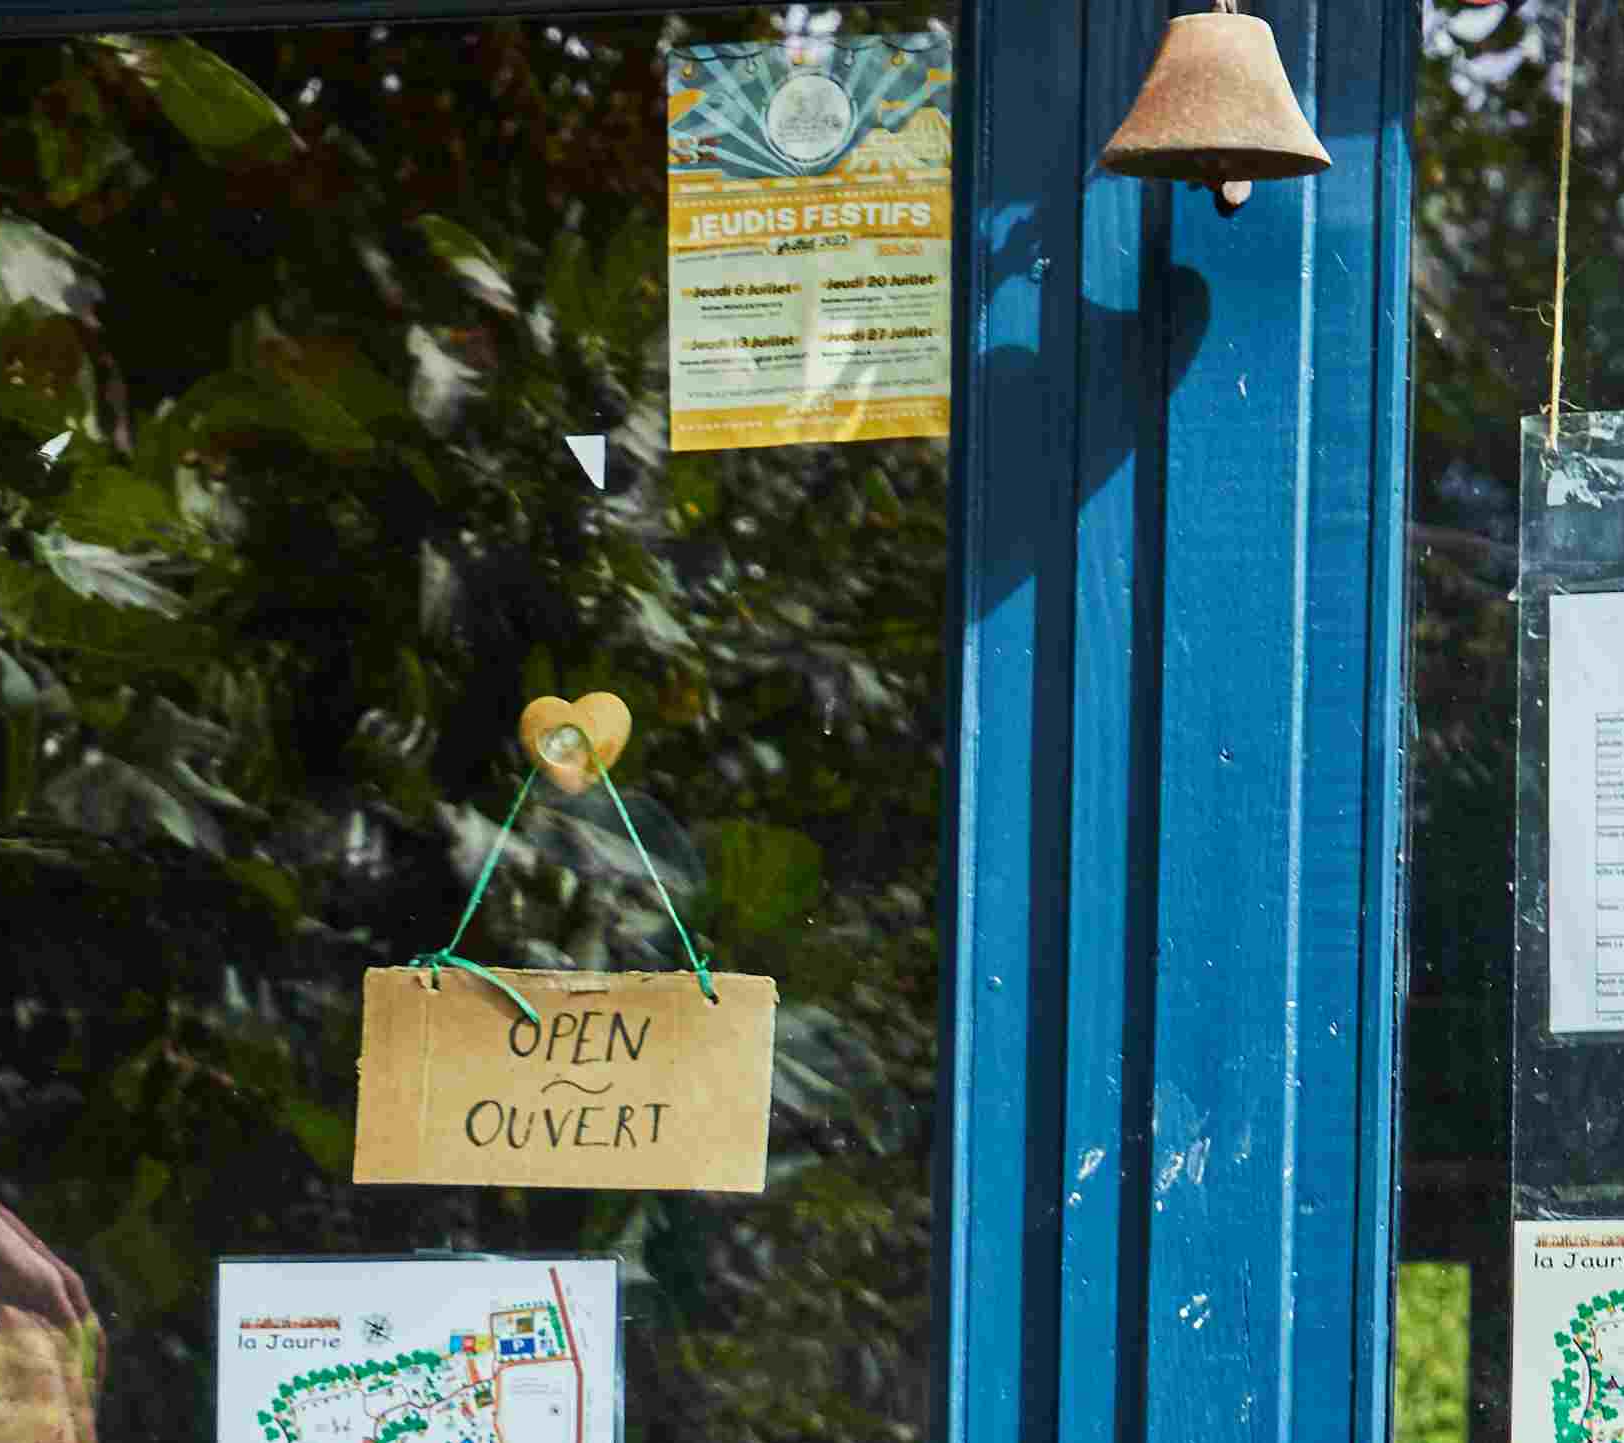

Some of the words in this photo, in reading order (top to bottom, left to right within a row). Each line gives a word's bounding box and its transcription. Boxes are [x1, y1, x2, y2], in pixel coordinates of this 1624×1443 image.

[689, 207, 797, 242] JEUDIS
[804, 201, 931, 230] FESTIFS
[508, 1010, 652, 1065] OPEN
[464, 1098, 675, 1149] OUVERT
[1534, 1252, 1554, 1269] la
[237, 1334, 258, 1350] la
[265, 1333, 342, 1350] Jaurie
